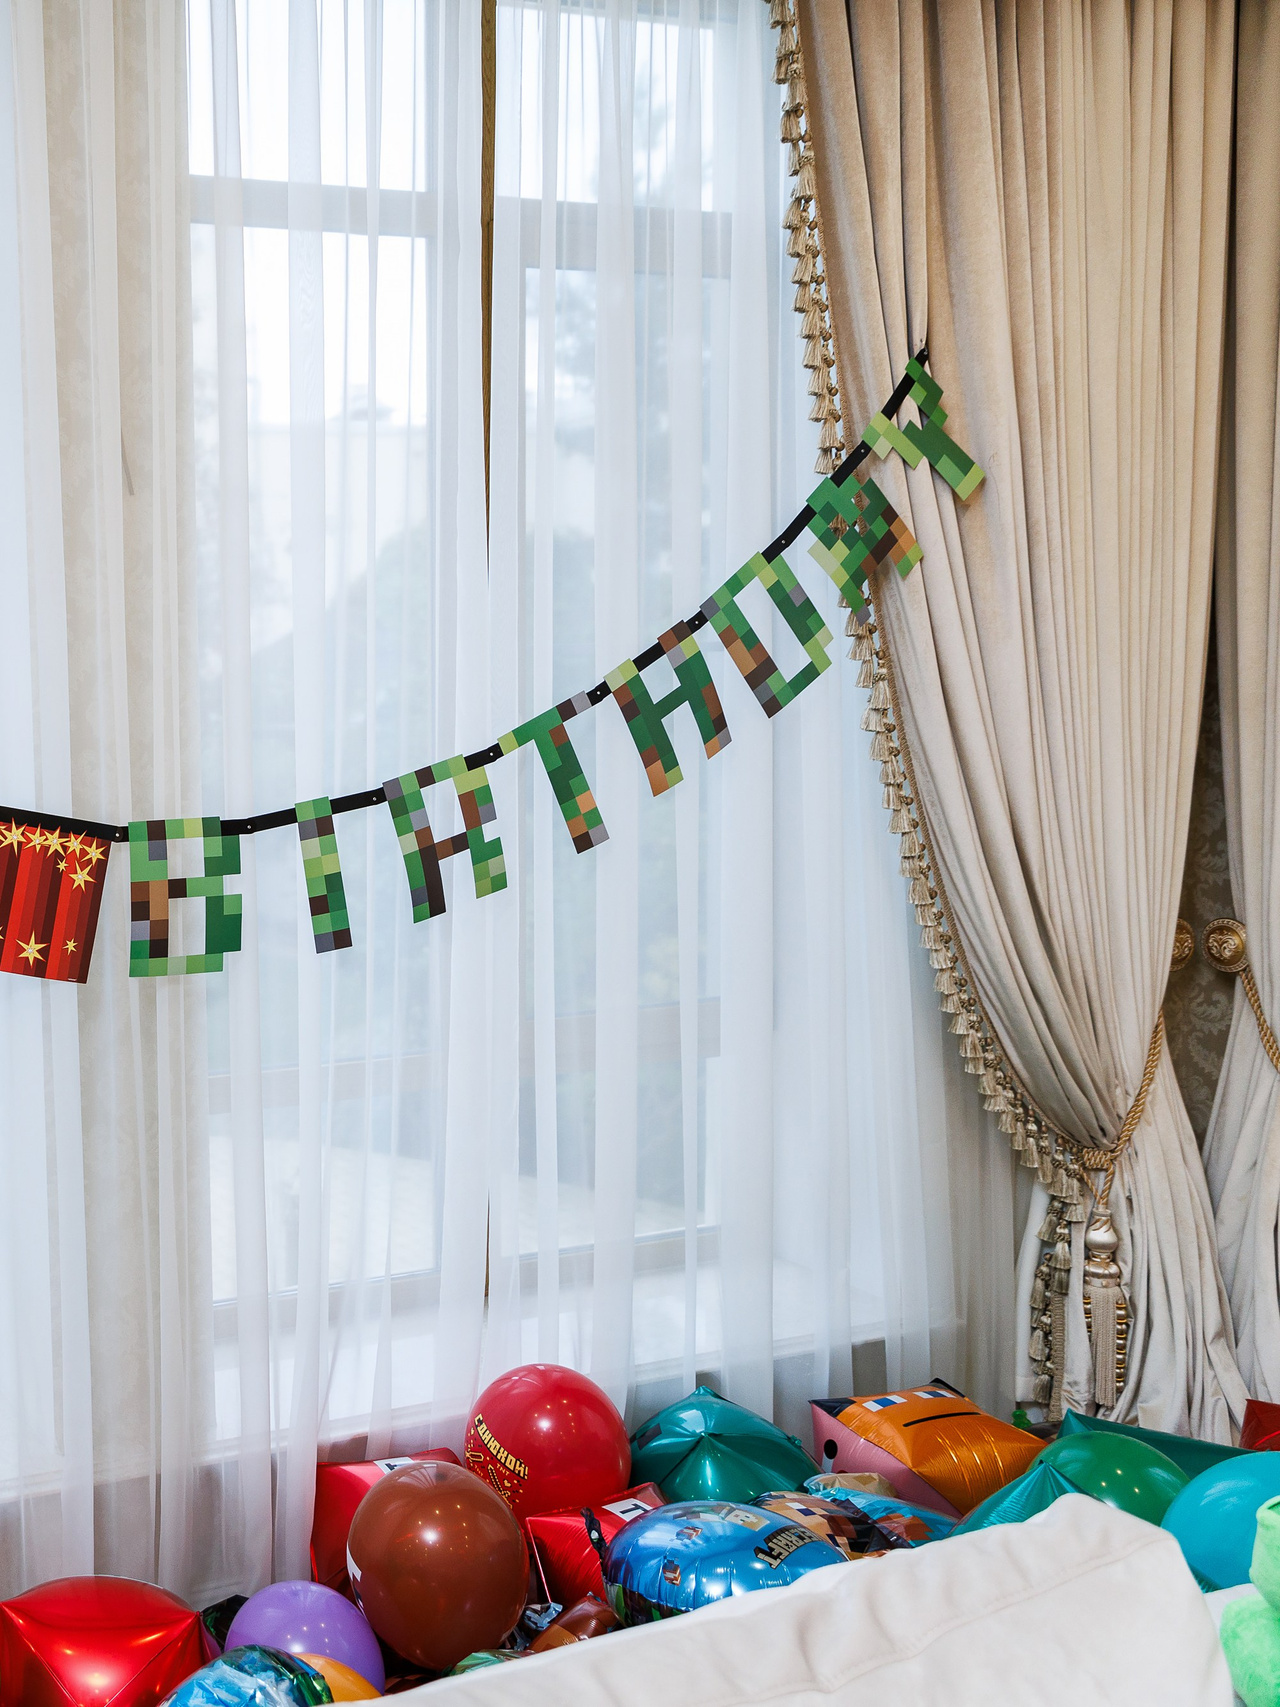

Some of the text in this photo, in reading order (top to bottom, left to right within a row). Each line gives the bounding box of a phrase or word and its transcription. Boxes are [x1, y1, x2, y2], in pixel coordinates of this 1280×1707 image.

[128, 356, 985, 977] BIRTHDAY
[496, 1463, 510, 1476] TNT
[754, 1525, 822, 1570] ECRAFT
